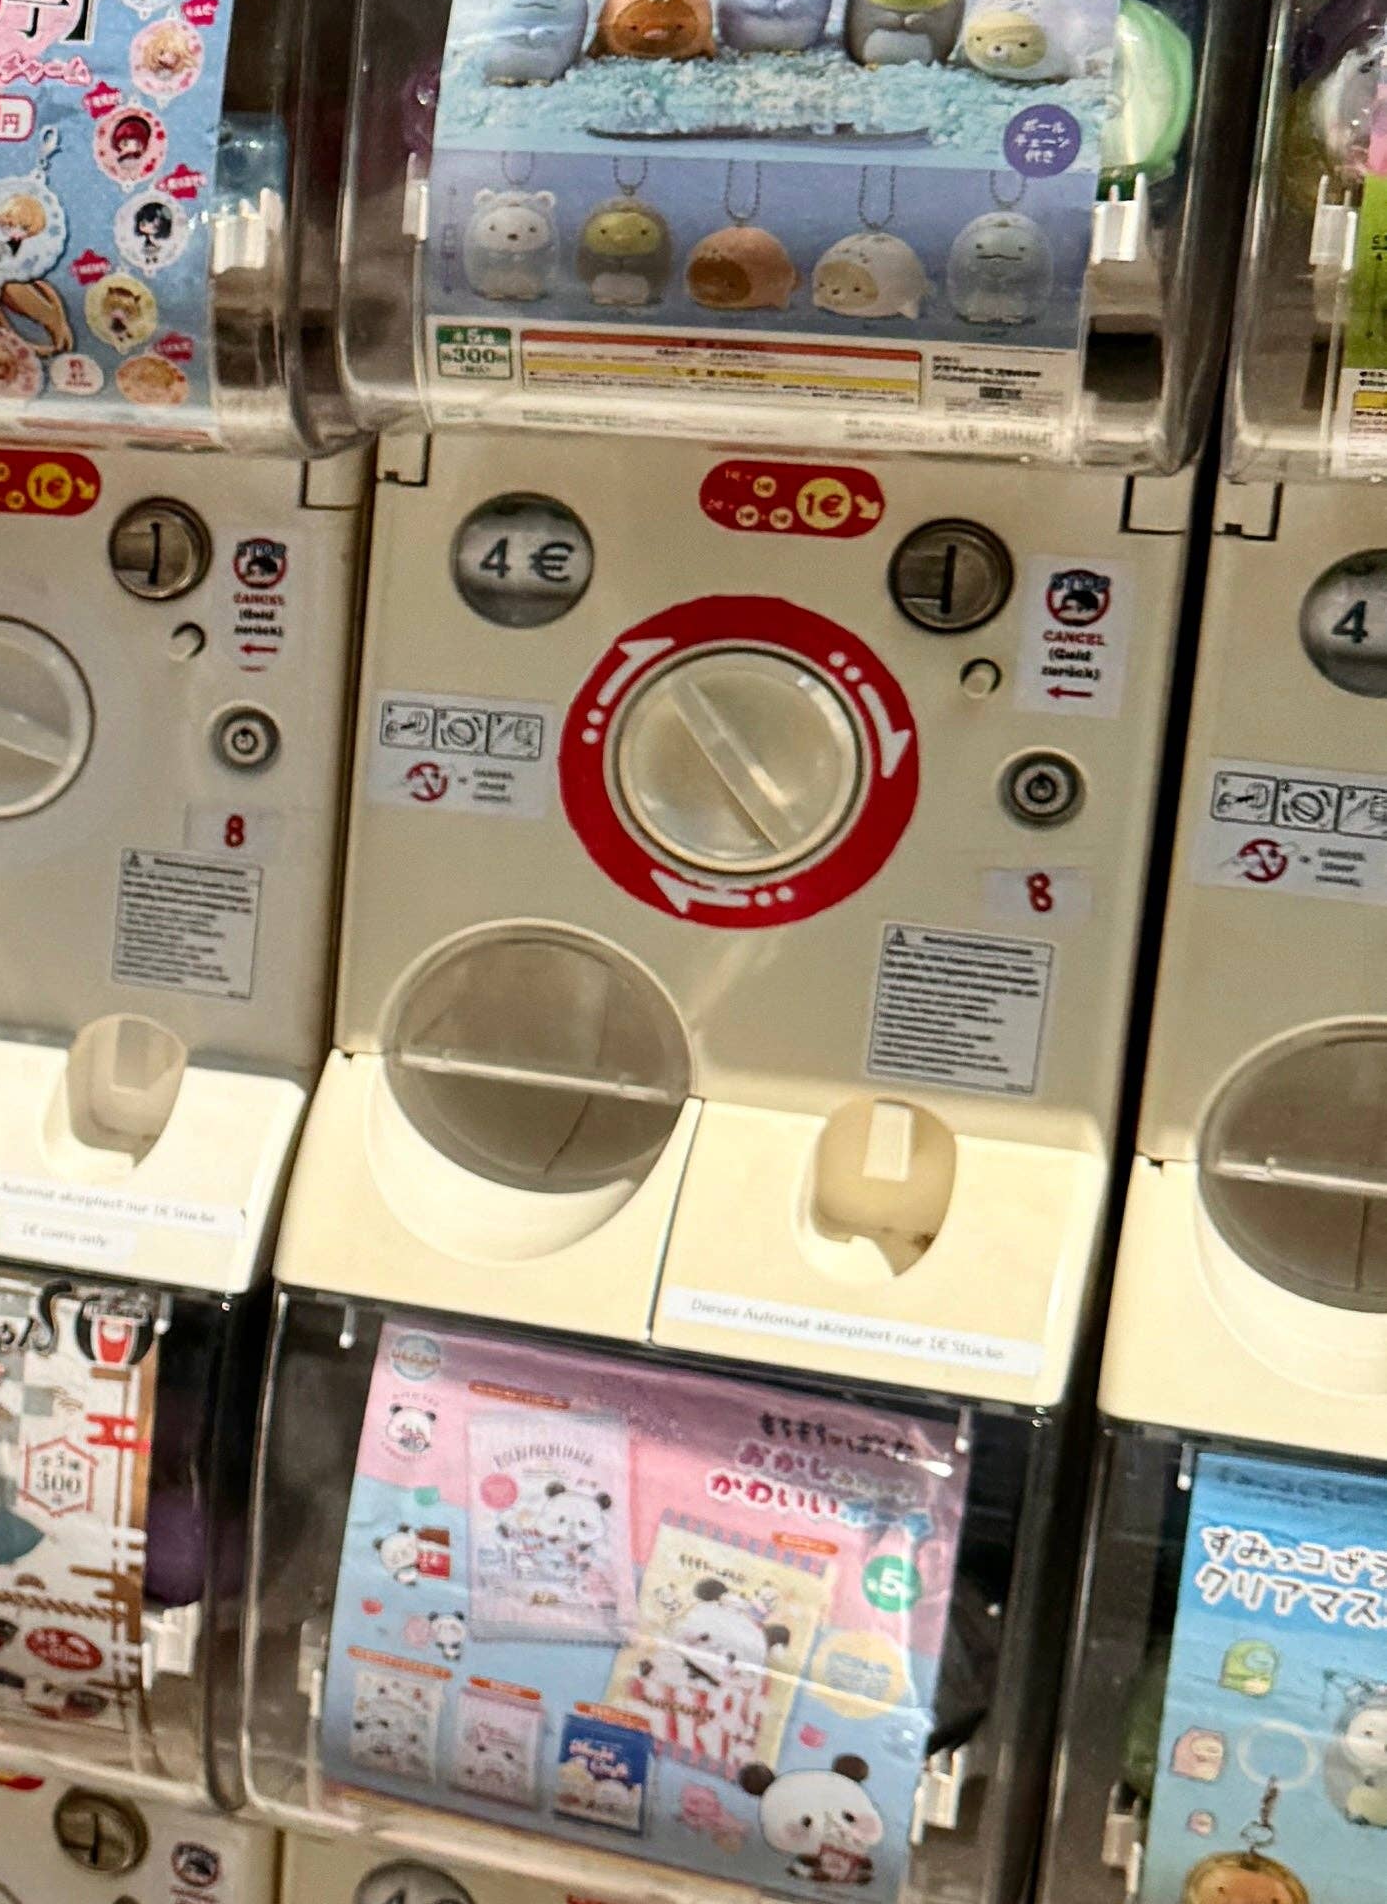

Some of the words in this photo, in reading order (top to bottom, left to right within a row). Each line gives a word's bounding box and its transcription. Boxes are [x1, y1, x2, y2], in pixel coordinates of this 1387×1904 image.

[479, 538, 511, 580] 4
[529, 540, 575, 583] €
[1330, 599, 1369, 645] 4
